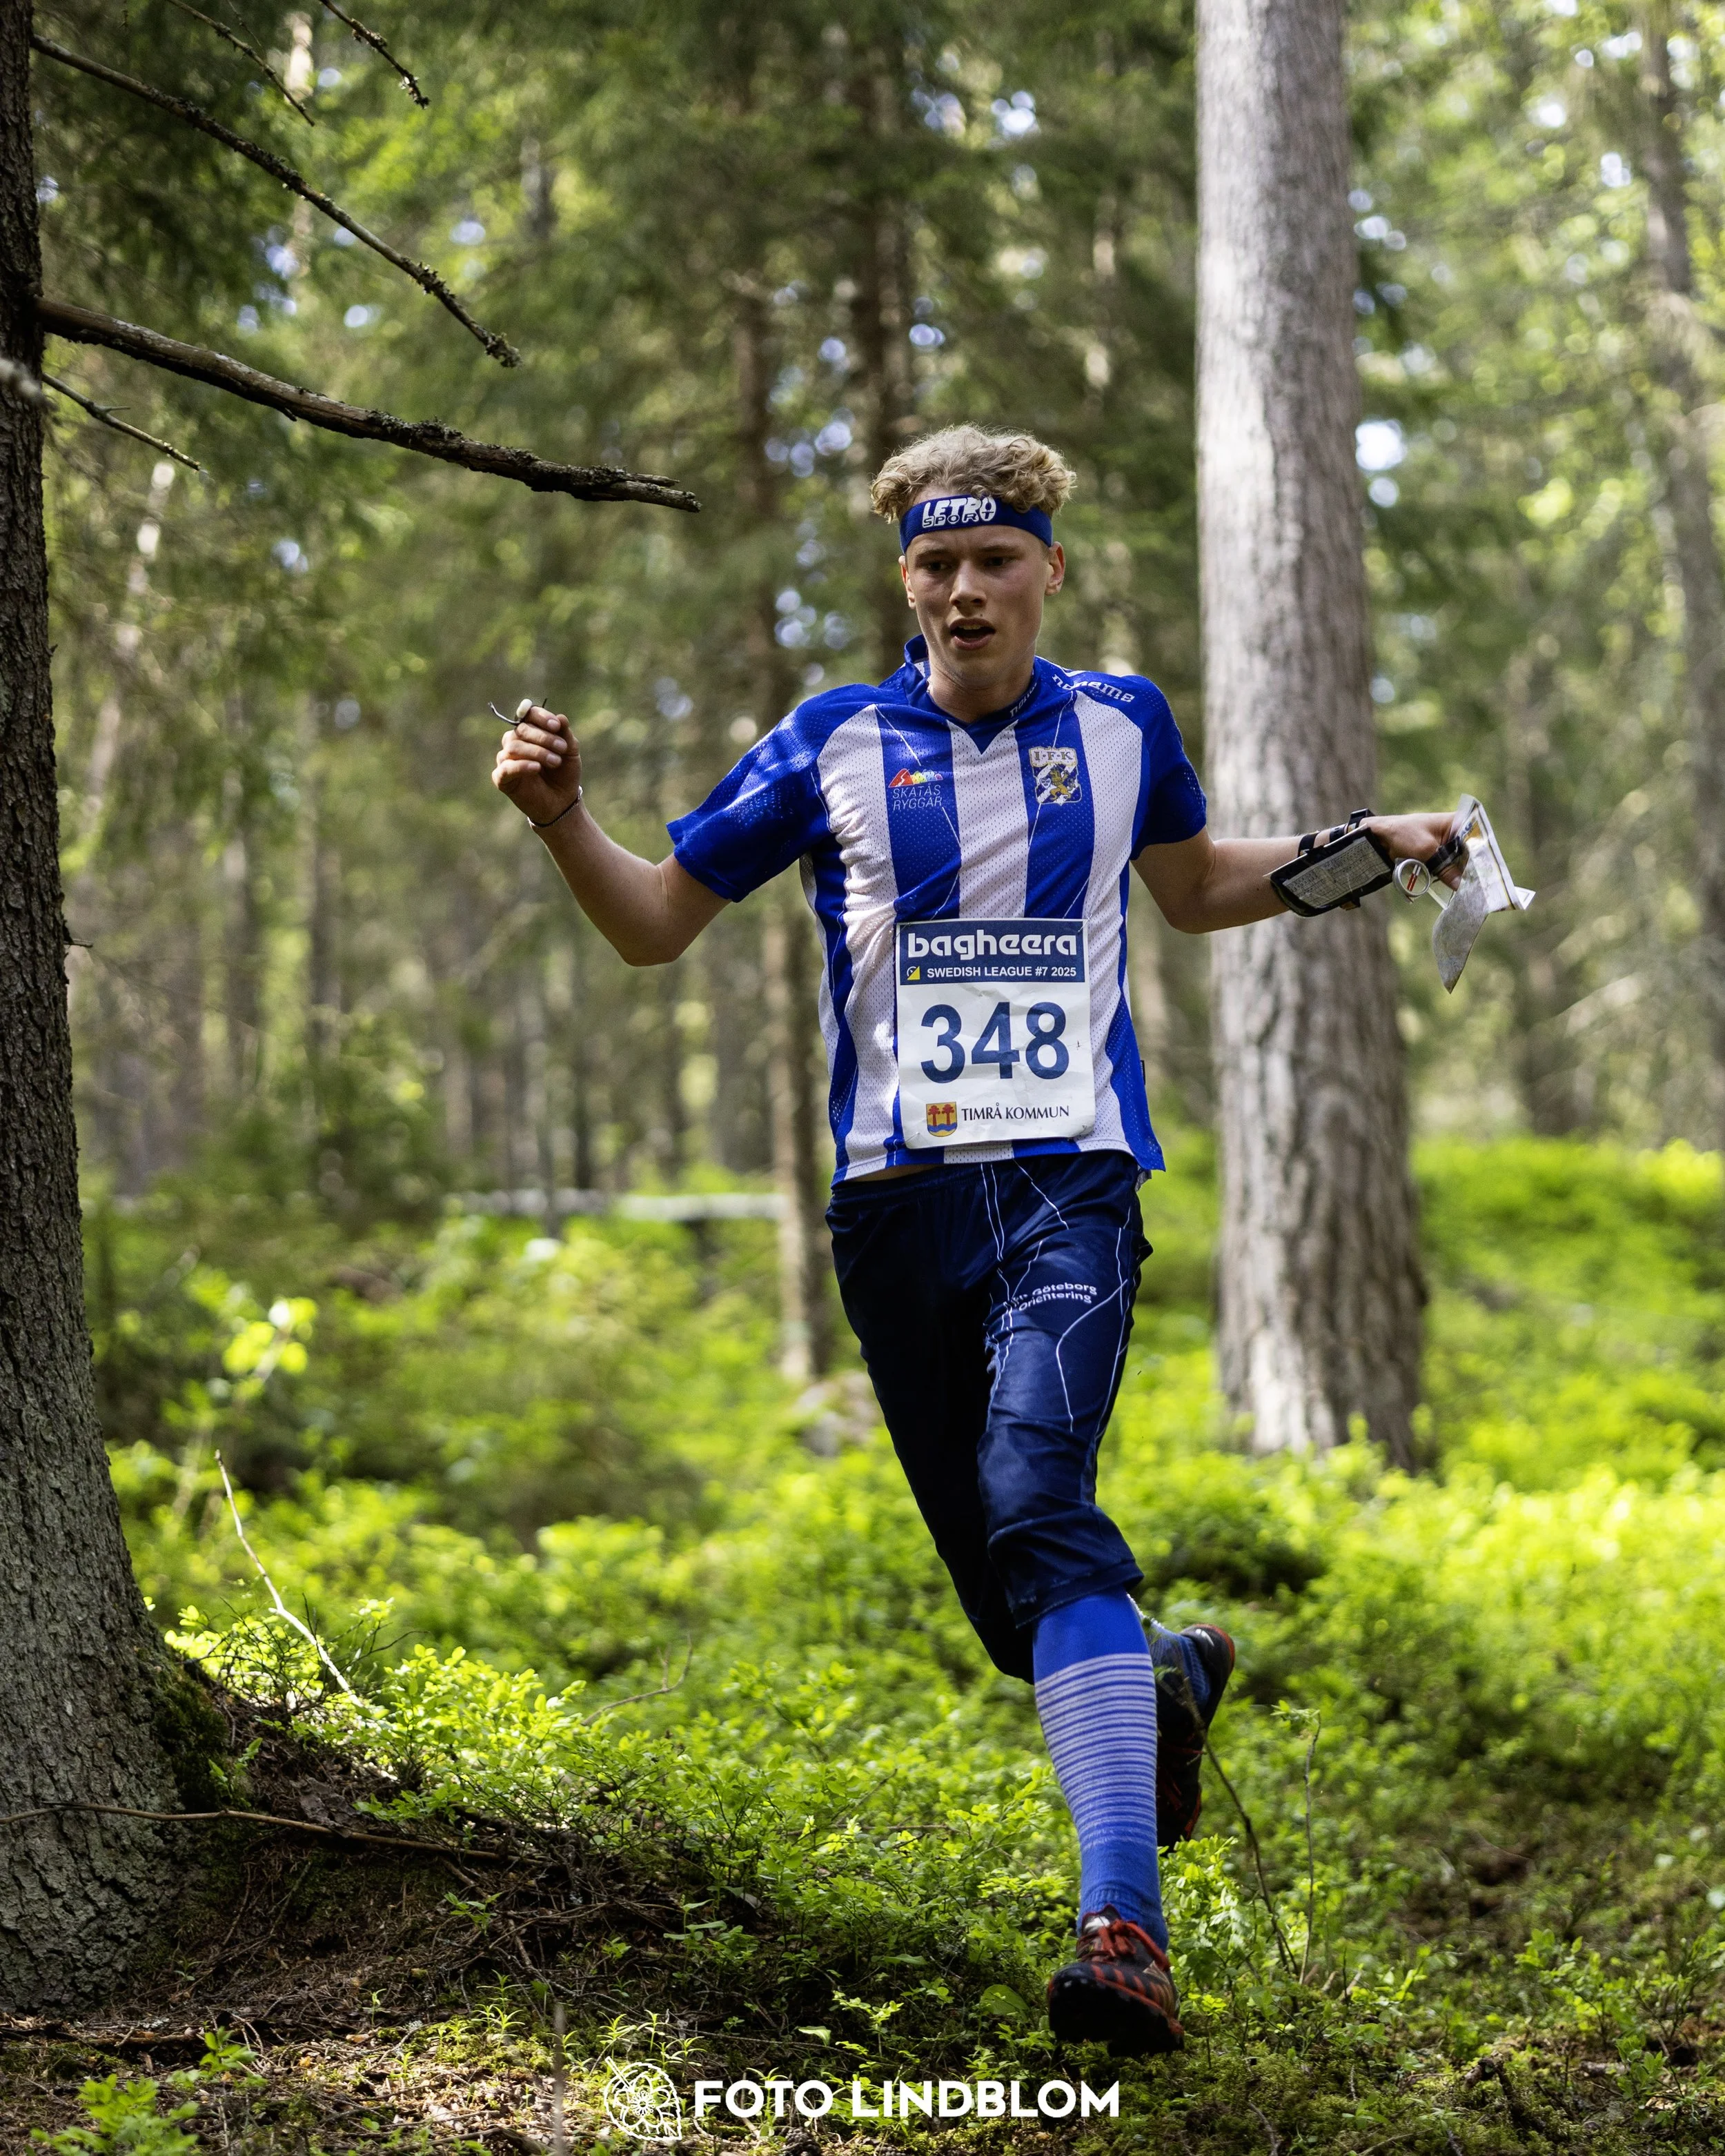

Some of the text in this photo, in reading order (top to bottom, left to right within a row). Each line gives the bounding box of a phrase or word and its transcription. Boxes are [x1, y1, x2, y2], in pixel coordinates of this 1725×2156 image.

[923, 511, 994, 526] SPORT
[893, 795, 943, 811] RYGGAR
[908, 929, 1077, 960] bagheera
[927, 966, 1076, 978] SWEDISH LEAGUE #7 2025
[920, 1001, 1070, 1084] 348
[961, 1102, 1070, 1121] TIMRÅ KOMMUN
[1032, 1282, 1098, 1296] Göteborg
[1018, 1291, 1092, 1312] Orientering
